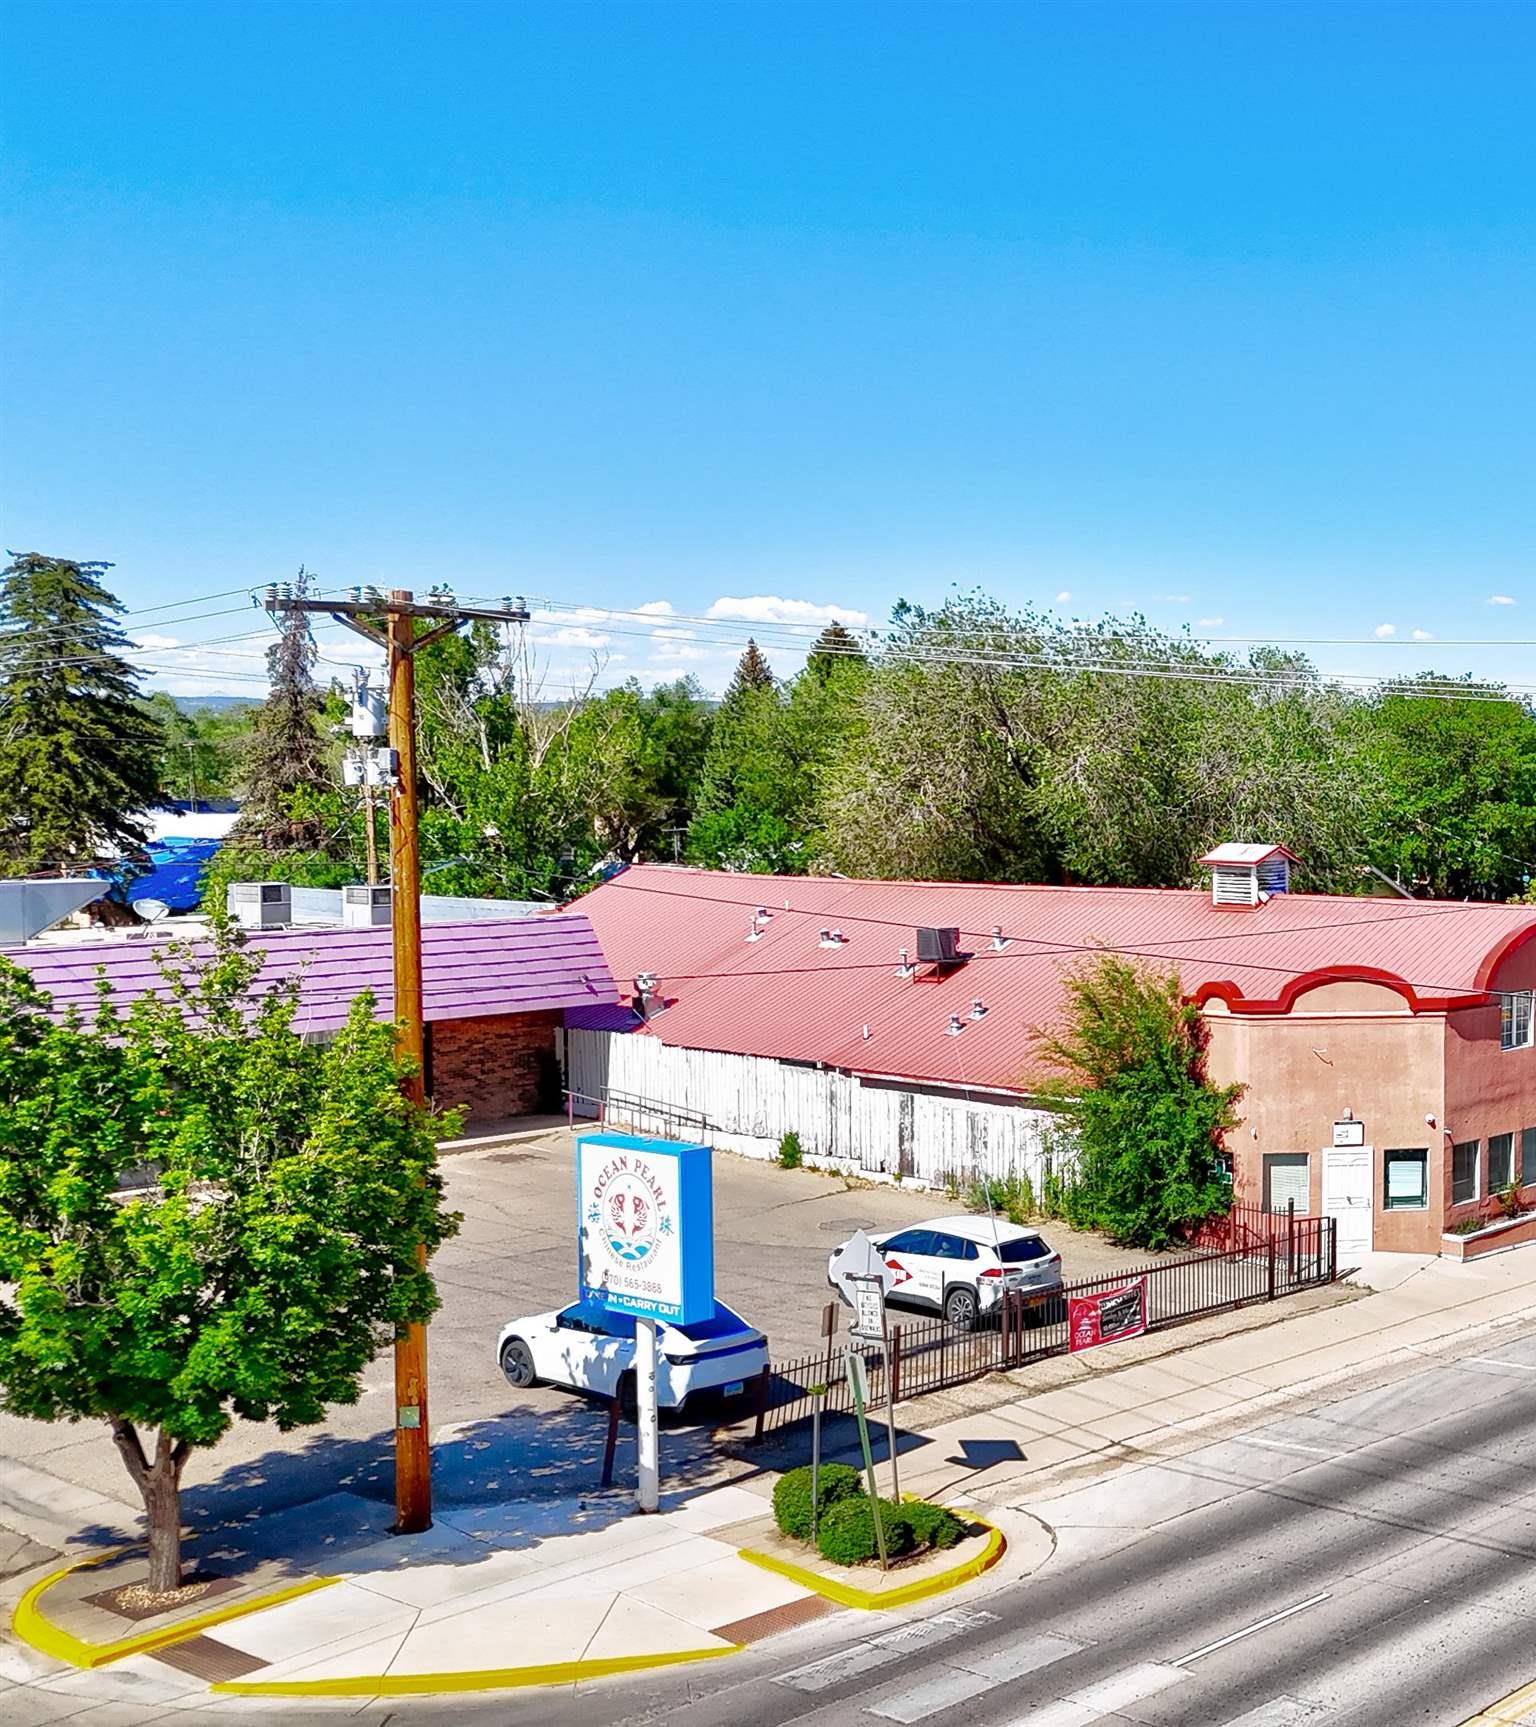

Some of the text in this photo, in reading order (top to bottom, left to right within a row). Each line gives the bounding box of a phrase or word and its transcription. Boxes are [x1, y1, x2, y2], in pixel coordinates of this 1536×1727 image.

[594, 1156, 666, 1212] OCEAN PEARL
[599, 1228, 662, 1273] Chinese Restaurant
[623, 1296, 657, 1312] CARRY
[658, 1303, 680, 1317] OUT
